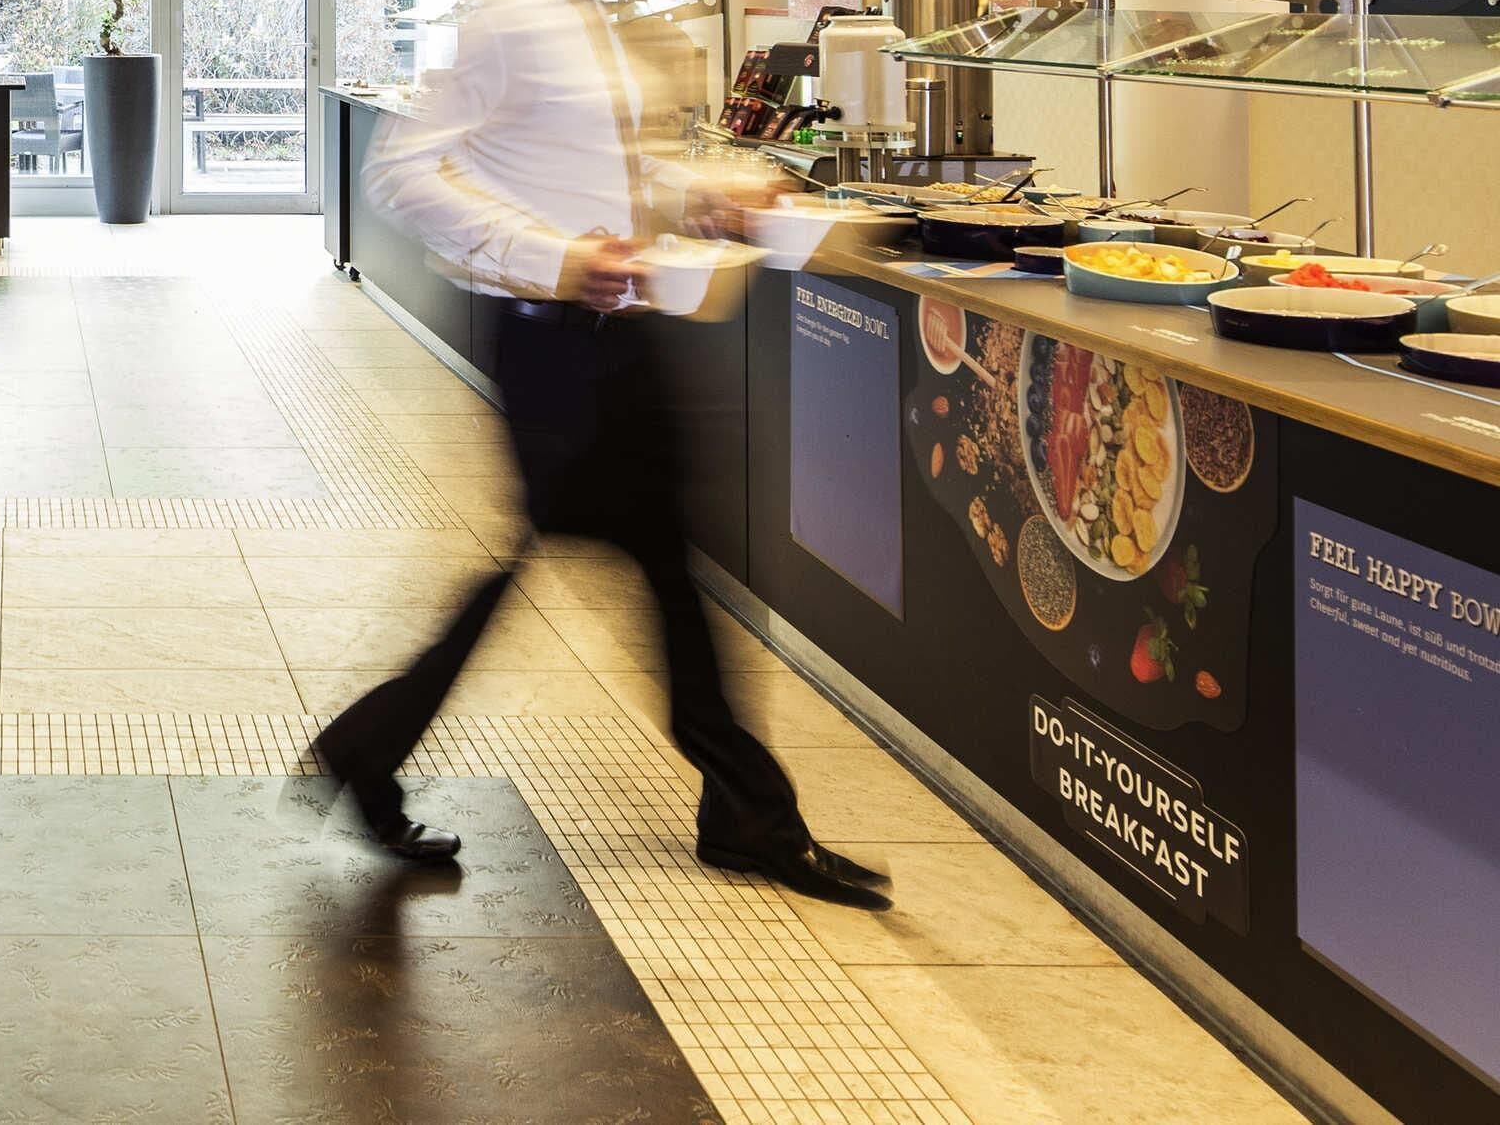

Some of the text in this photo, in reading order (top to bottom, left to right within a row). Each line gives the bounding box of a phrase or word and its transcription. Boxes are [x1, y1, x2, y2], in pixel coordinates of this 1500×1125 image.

[864, 316, 889, 340] BOWL
[1309, 531, 1360, 575] FEEL
[1366, 555, 1443, 609] HAPPY
[1309, 577, 1333, 600] Sorgt
[1336, 587, 1349, 604] für
[1351, 598, 1373, 615] gute
[1408, 620, 1422, 638] ist
[1446, 641, 1466, 658] und
[1352, 618, 1379, 639] sweet
[1381, 630, 1400, 648] and
[1402, 640, 1418, 656] yet
[1033, 705, 1240, 865] DO-IT-YOURSELF
[1059, 767, 1209, 897] BREAKFAST
